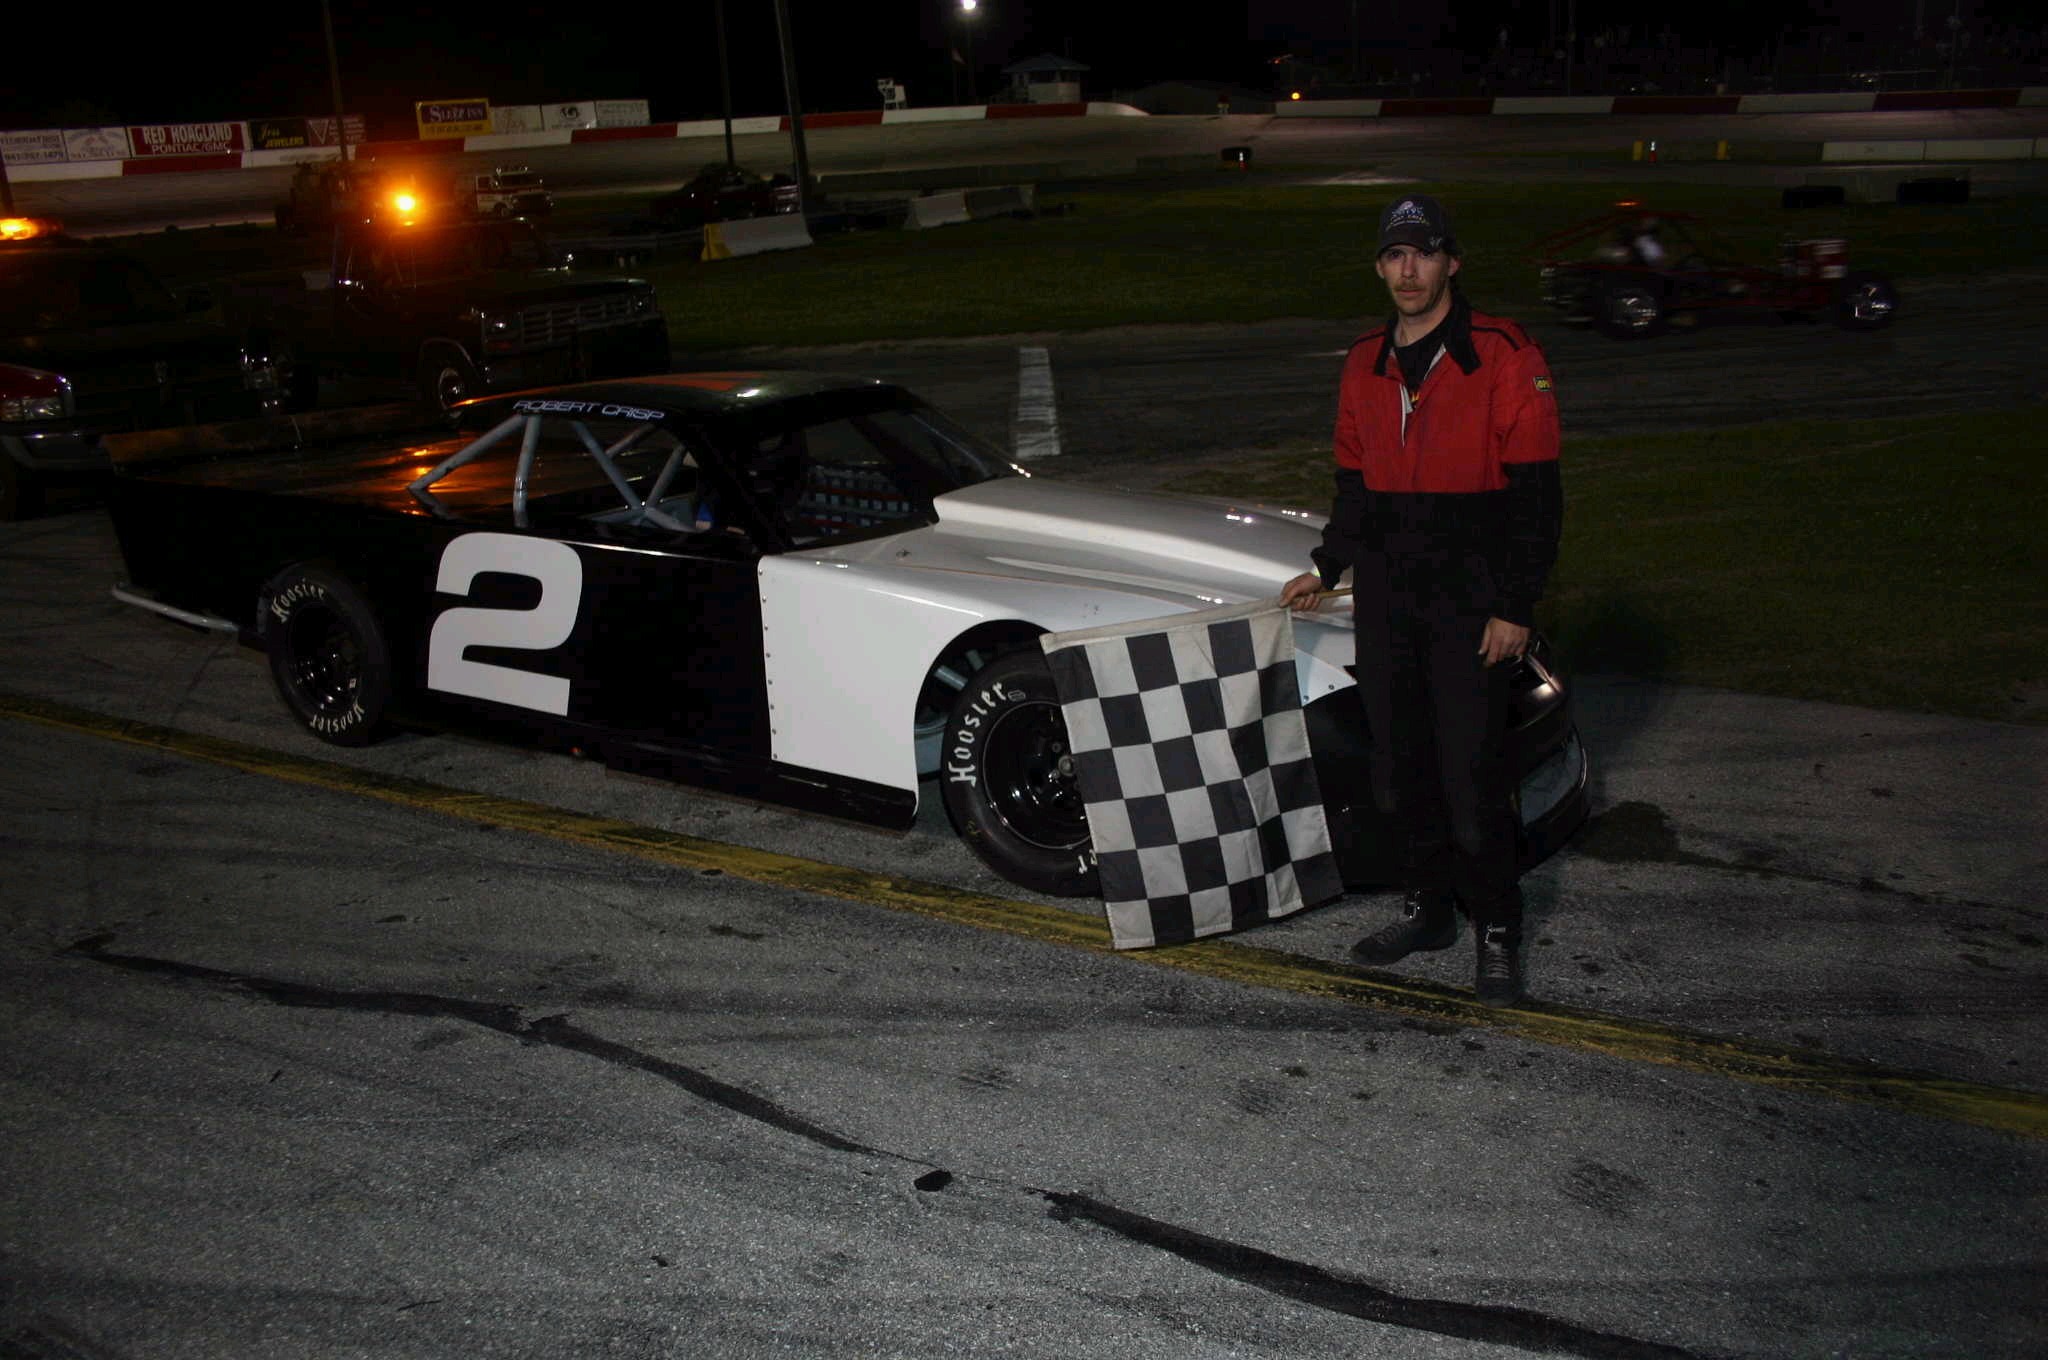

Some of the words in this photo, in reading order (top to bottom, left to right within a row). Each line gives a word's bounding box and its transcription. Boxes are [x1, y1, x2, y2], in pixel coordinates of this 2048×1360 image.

[143, 126, 167, 145] RED
[512, 400, 600, 413] ROBERT
[601, 404, 665, 421] CRISP
[271, 577, 327, 624] Hoosier
[427, 531, 583, 717] 2
[309, 696, 366, 732] Hoosier
[948, 681, 1007, 788] Hoosier
